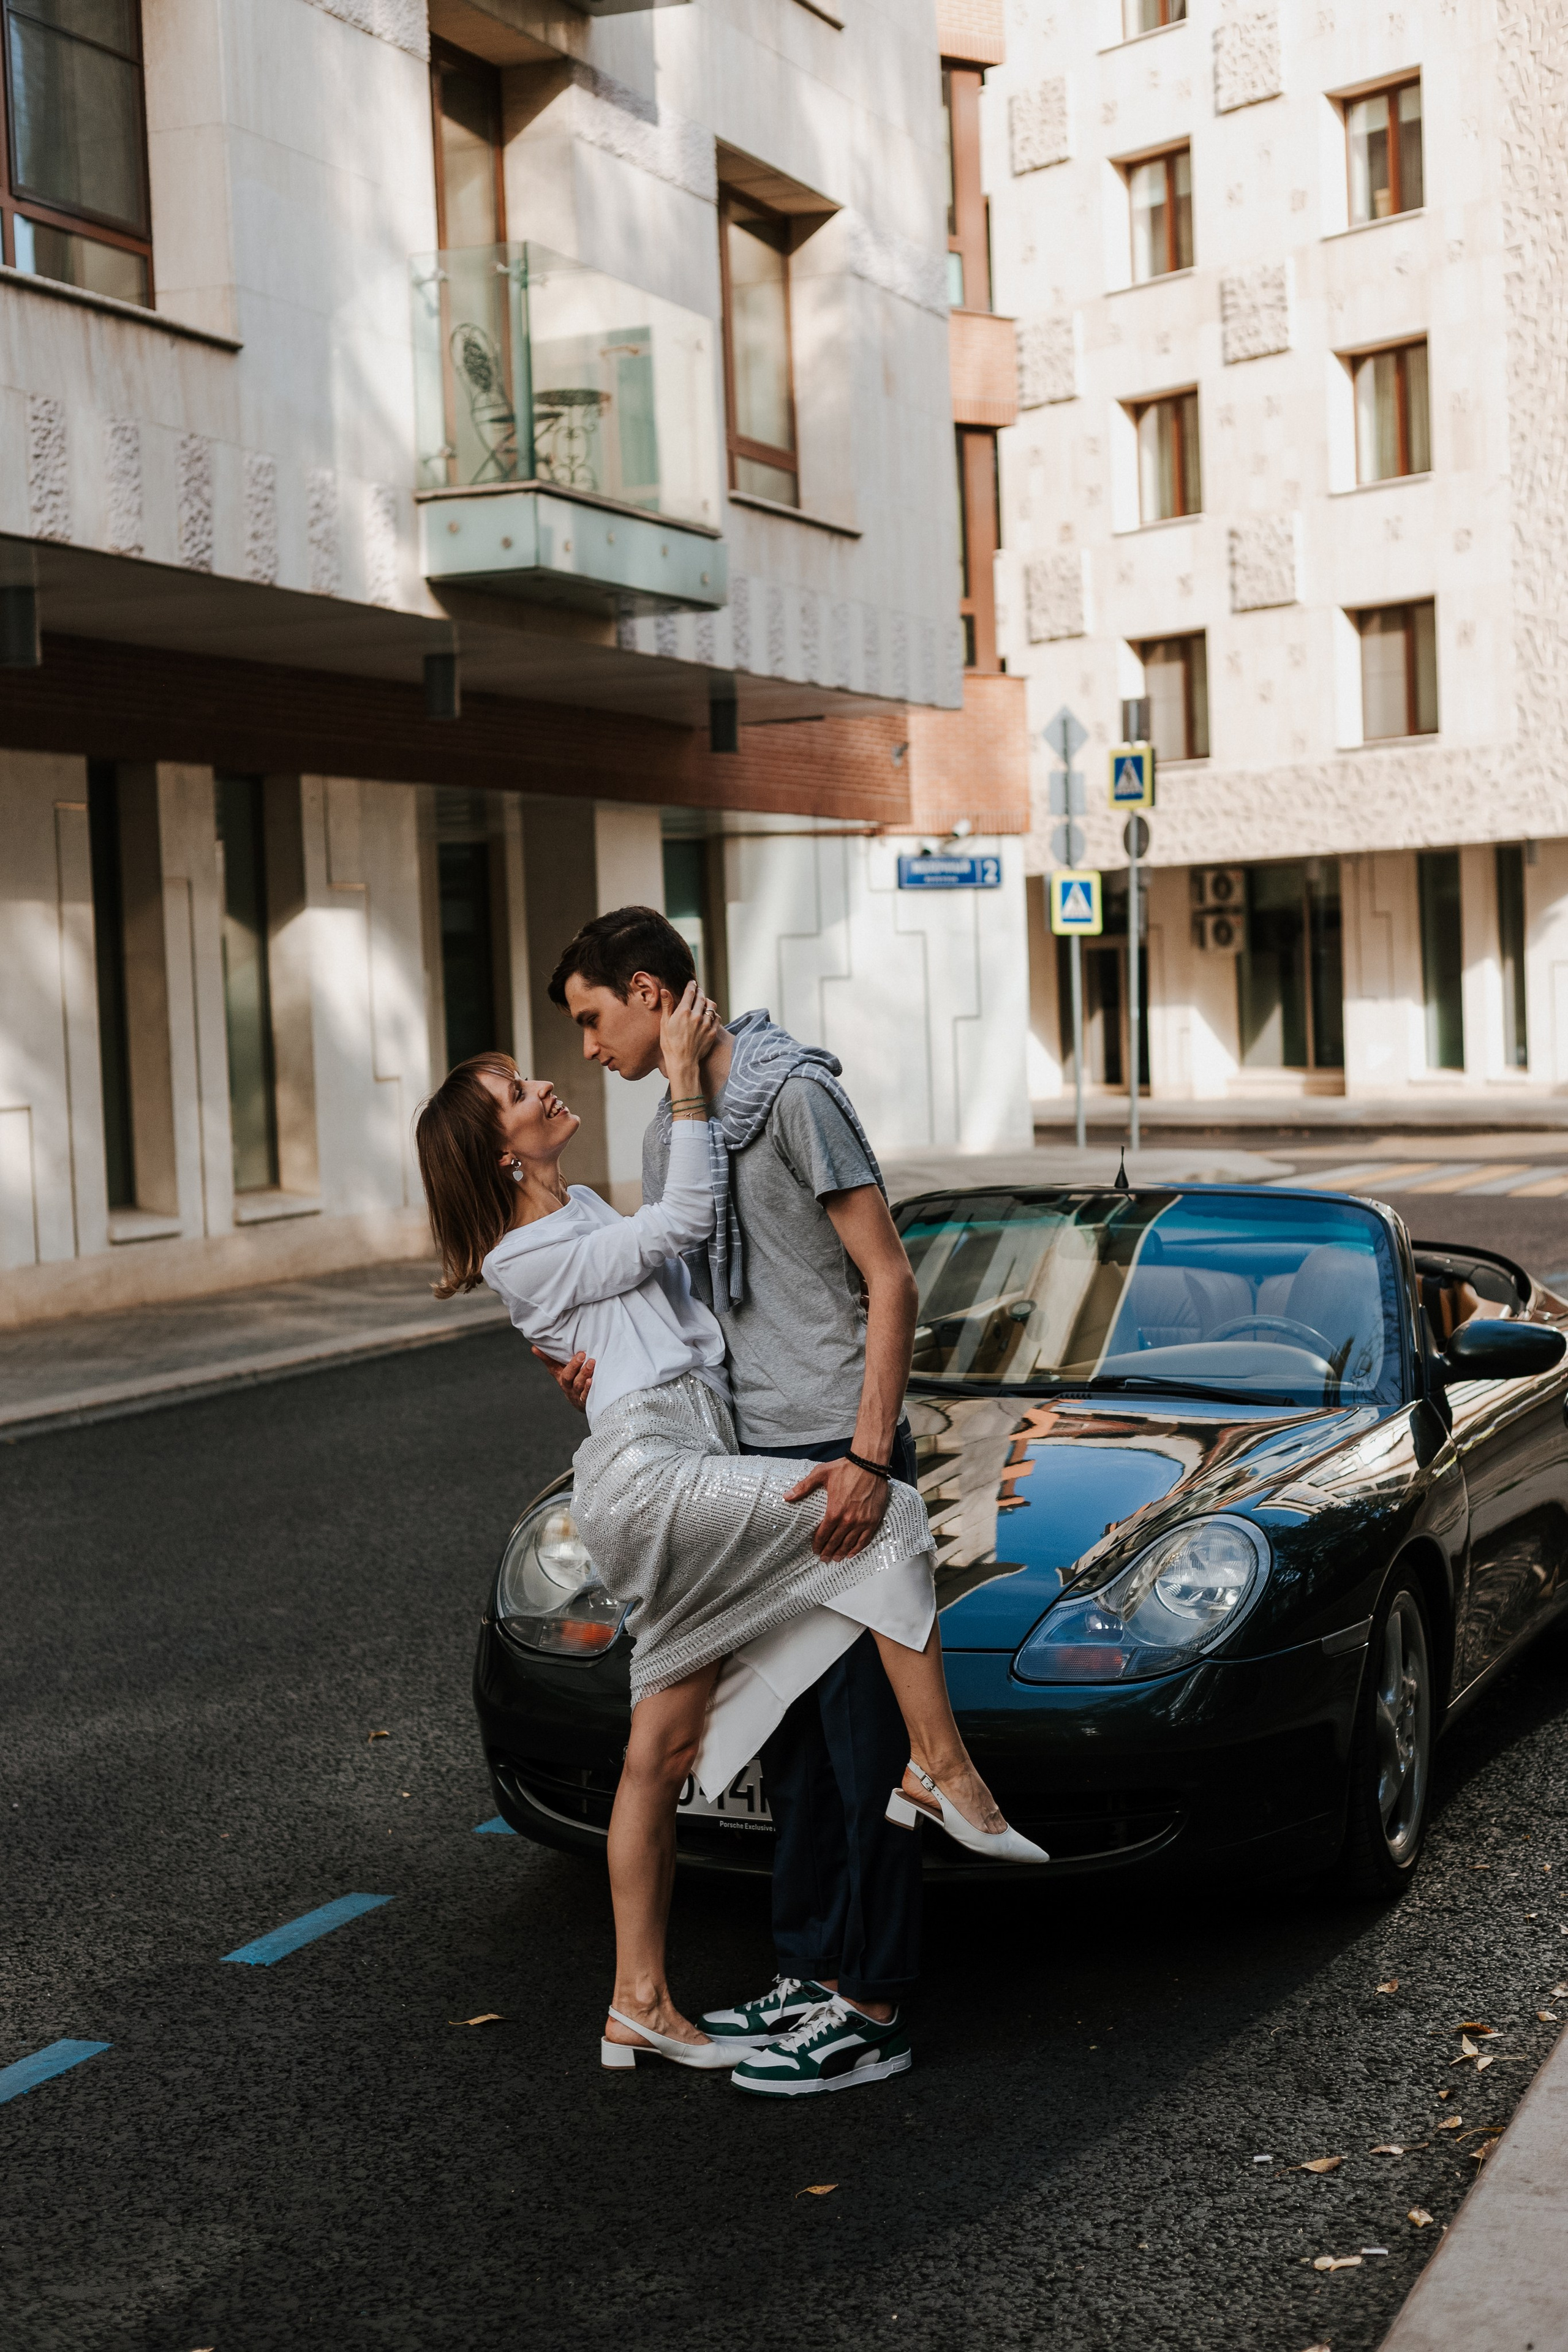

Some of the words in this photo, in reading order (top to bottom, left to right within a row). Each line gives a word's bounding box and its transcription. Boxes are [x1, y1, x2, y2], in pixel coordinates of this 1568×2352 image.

[982, 859, 998, 883] 2
[720, 1820, 744, 1829] Porsche
[744, 1823, 773, 1831] Exclusive
